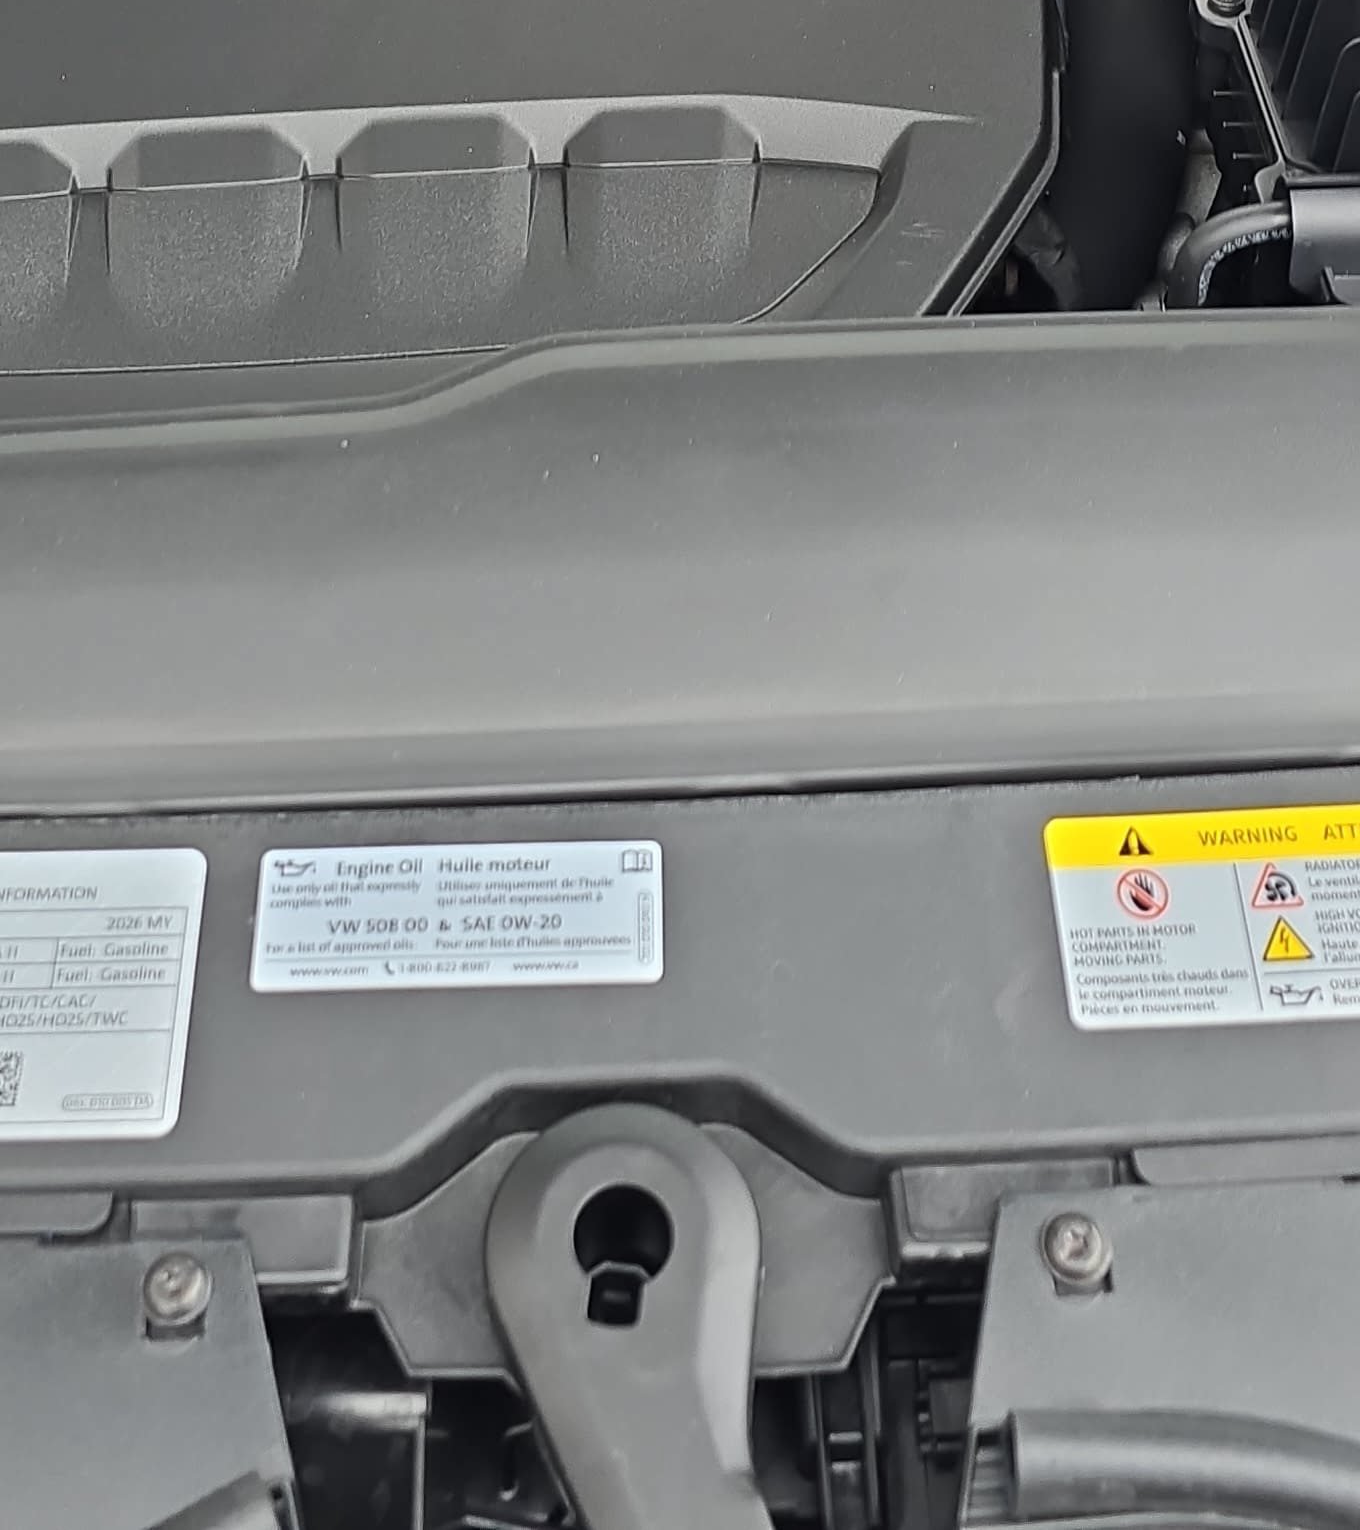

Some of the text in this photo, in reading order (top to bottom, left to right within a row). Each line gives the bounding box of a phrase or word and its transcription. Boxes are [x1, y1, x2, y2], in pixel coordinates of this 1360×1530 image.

[1197, 826, 1298, 847] WARNING
[337, 858, 423, 878] Engine Oil
[439, 857, 550, 873] Huile moteur
[271, 884, 293, 895] Use
[296, 883, 321, 895] only
[340, 881, 364, 892] that
[367, 880, 421, 894] expressly
[438, 880, 482, 892] Utiliser
[485, 877, 559, 892] uniquement
[561, 877, 577, 889] de
[1308, 877, 1321, 887] Le
[270, 897, 352, 909] complies with
[437, 895, 457, 907] qui
[460, 893, 506, 905] satisfait
[106, 915, 173, 930] 2026 MY
[1315, 909, 1346, 921] HIGH
[328, 918, 361, 935] VW
[404, 917, 429, 932] 00
[462, 916, 496, 932] SAE
[500, 914, 563, 931] 0W-20
[1070, 923, 1196, 939] HOT PARTS IN MOTOR
[60, 941, 168, 957] Fuel: Gasoline
[266, 942, 284, 954] For
[298, 941, 316, 953] list
[318, 940, 332, 952] of
[334, 939, 391, 954] approved
[435, 938, 462, 950] Pour
[465, 938, 487, 949] une
[490, 936, 515, 948] liste
[1322, 939, 1359, 951] Haute
[1074, 955, 1123, 968] MOVING
[57, 966, 166, 981] Fuel: Gasoline
[1076, 968, 1250, 987] Composants très chauds dans
[1078, 988, 1090, 1000] le
[1092, 986, 1181, 1001] compartiment
[1081, 1001, 1119, 1015] Pièces
[1123, 1002, 1139, 1013] en
